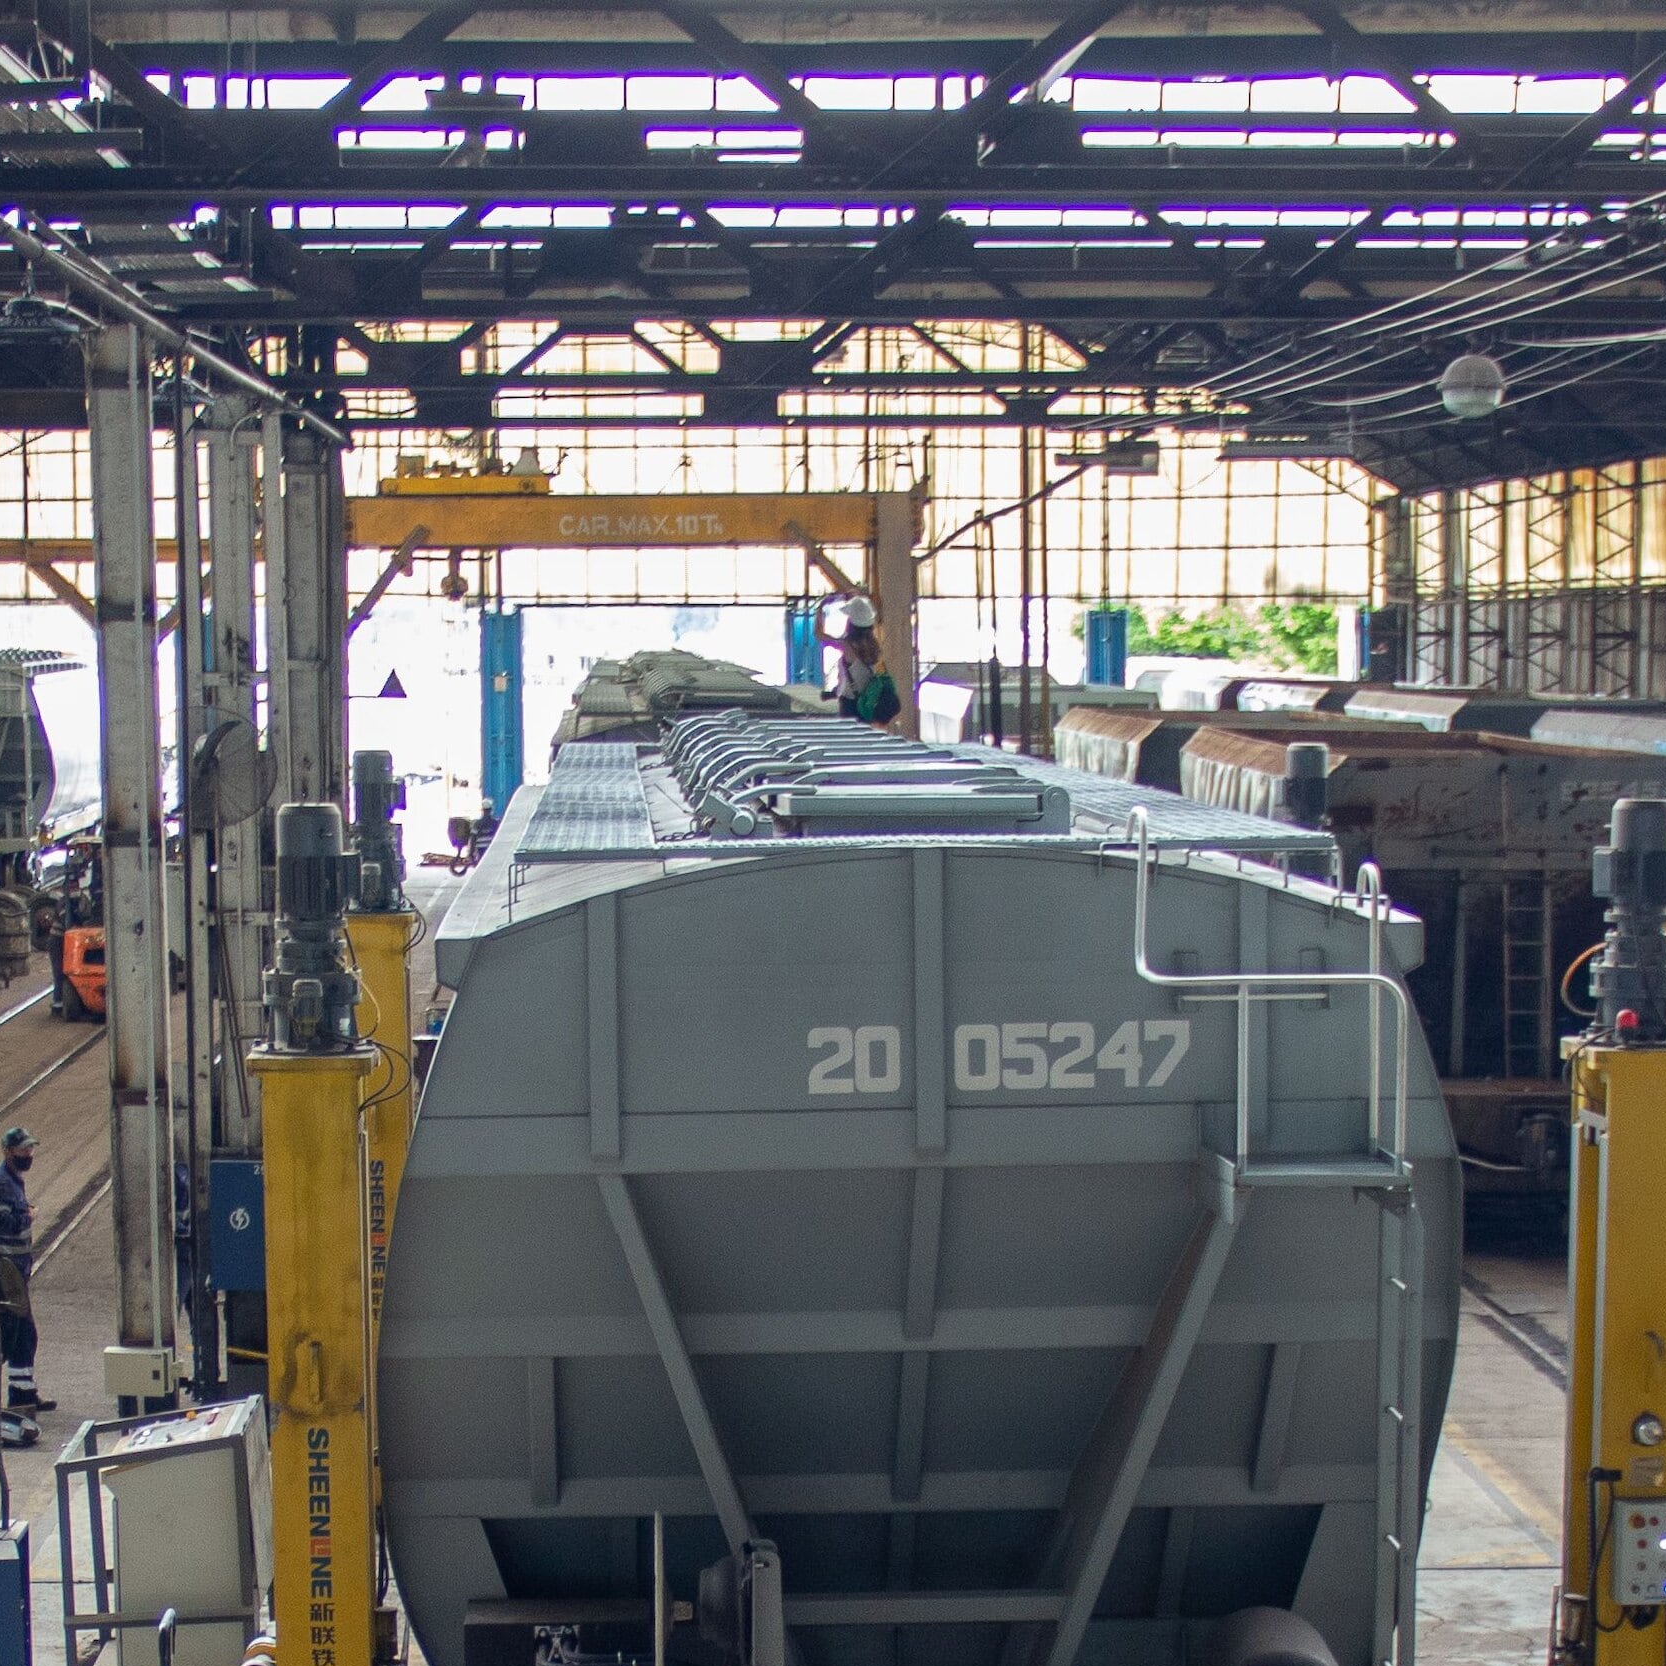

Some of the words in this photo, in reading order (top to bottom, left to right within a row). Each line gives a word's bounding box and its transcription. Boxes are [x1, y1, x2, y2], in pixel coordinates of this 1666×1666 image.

[807, 1025, 901, 1095] 20
[953, 1019, 1191, 1091] 05247
[307, 1426, 332, 1600] SHEENLINE
